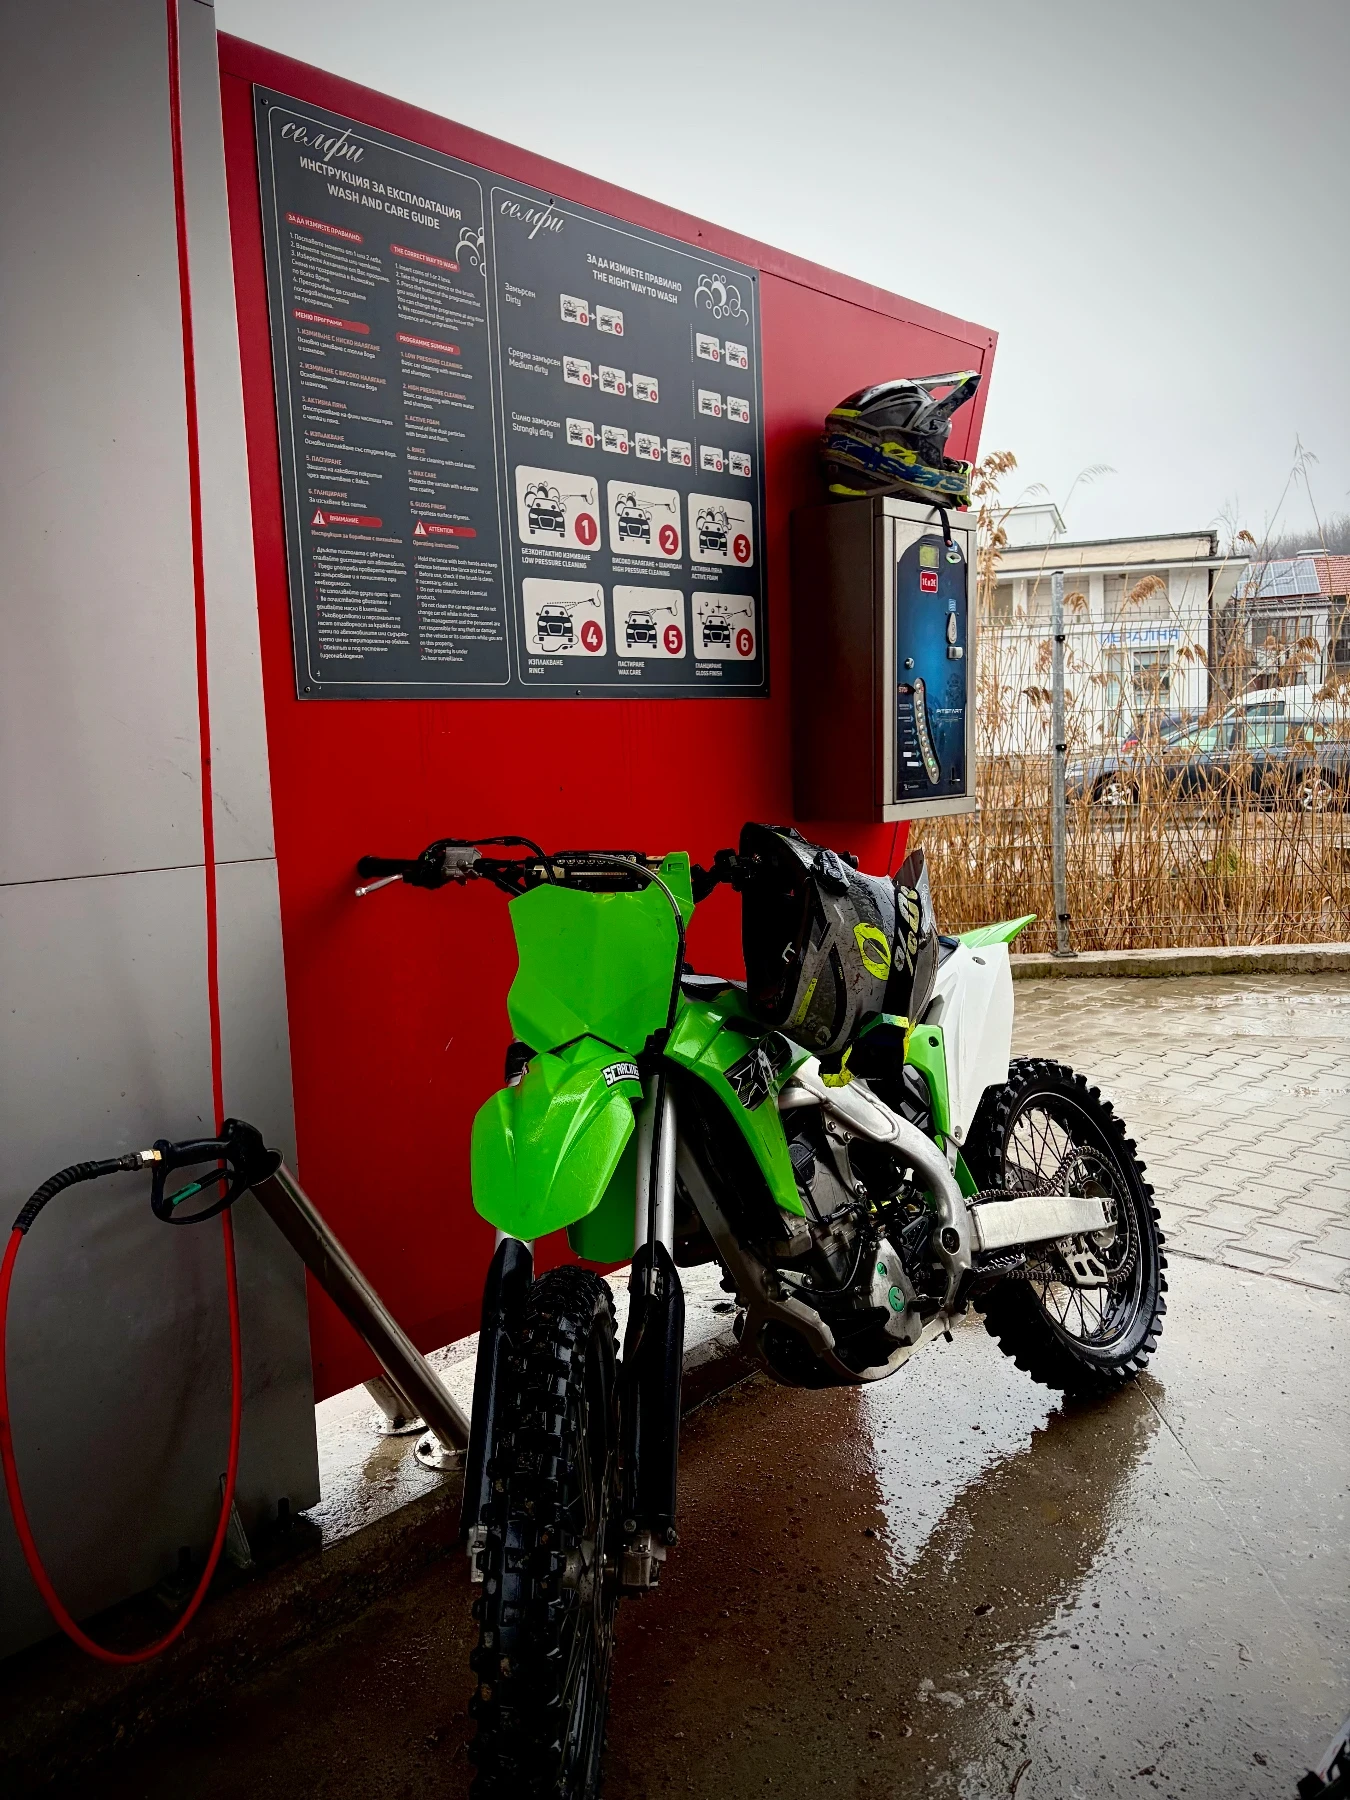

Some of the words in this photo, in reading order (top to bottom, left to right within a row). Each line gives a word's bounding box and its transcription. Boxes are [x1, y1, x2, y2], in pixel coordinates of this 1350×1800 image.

[281, 122, 364, 162] селфи
[299, 156, 370, 191] ИНСТРУКЦИЯ
[372, 180, 385, 194] ЗА
[387, 185, 461, 221] ЕКСПЛОАТАЦИЯ
[327, 183, 359, 203] WASH
[360, 194, 382, 211] AND
[384, 201, 409, 219] CARE
[411, 210, 439, 229] GUIDE
[500, 199, 564, 238] селфи
[586, 252, 596, 265] ЗА
[597, 256, 608, 270] ДА
[609, 260, 643, 280] ИЗМИЕТЕ
[644, 272, 681, 293] ПРАВИЛНО
[504, 282, 535, 299] Замърсен
[592, 268, 606, 282] THE
[608, 274, 629, 290] RIGHT
[630, 281, 646, 295] WAY
[647, 286, 655, 298] TO
[657, 290, 677, 305] WASH
[505, 293, 521, 307] Dirty
[508, 347, 530, 360] Средно
[531, 353, 560, 368] замърсен
[508, 358, 532, 371] Medium
[534, 364, 548, 375] dirty
[511, 411, 530, 422] Силно
[531, 415, 560, 429] замърсен
[512, 422, 538, 436] Strongly
[539, 428, 553, 438] dirty
[428, 525, 453, 534] ATTENTION
[580, 518, 589, 539] 1
[664, 530, 674, 549] 2
[737, 539, 746, 558] 3
[521, 547, 562, 557] БЕЗКОНТАКТНО
[563, 552, 590, 560] ИЗМИВАНЕ
[535, 558, 561, 566] PRESSURE
[562, 560, 586, 568] CLEANING
[624, 566, 648, 574] PRESSURE
[586, 626, 597, 646] 4
[668, 630, 677, 648] 5
[740, 634, 748, 651] 6
